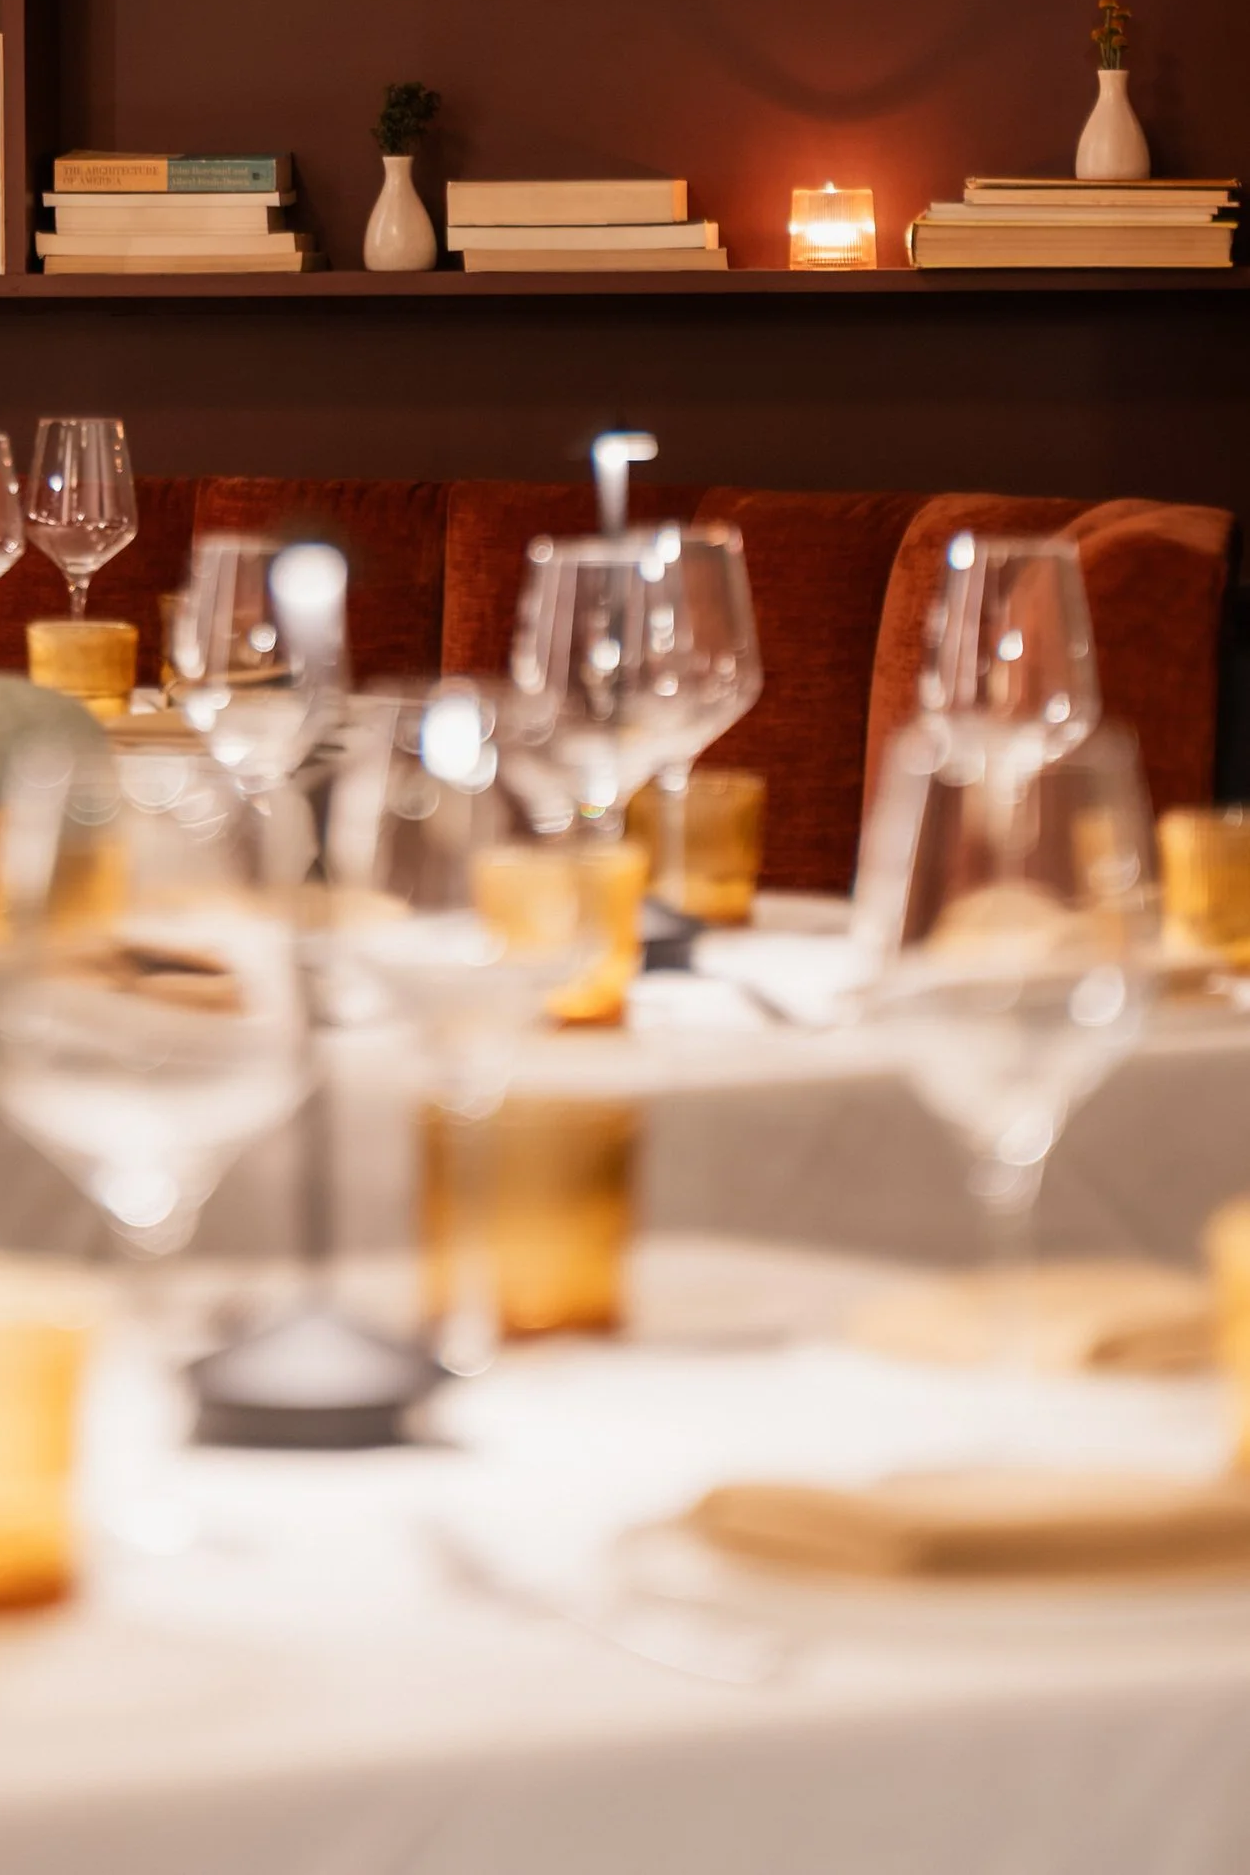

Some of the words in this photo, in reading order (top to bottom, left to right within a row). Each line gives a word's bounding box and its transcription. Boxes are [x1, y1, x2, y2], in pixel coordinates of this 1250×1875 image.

[63, 165, 81, 175] THE
[85, 165, 160, 175] ARCHITECTURE
[80, 177, 122, 186] AMERICA
